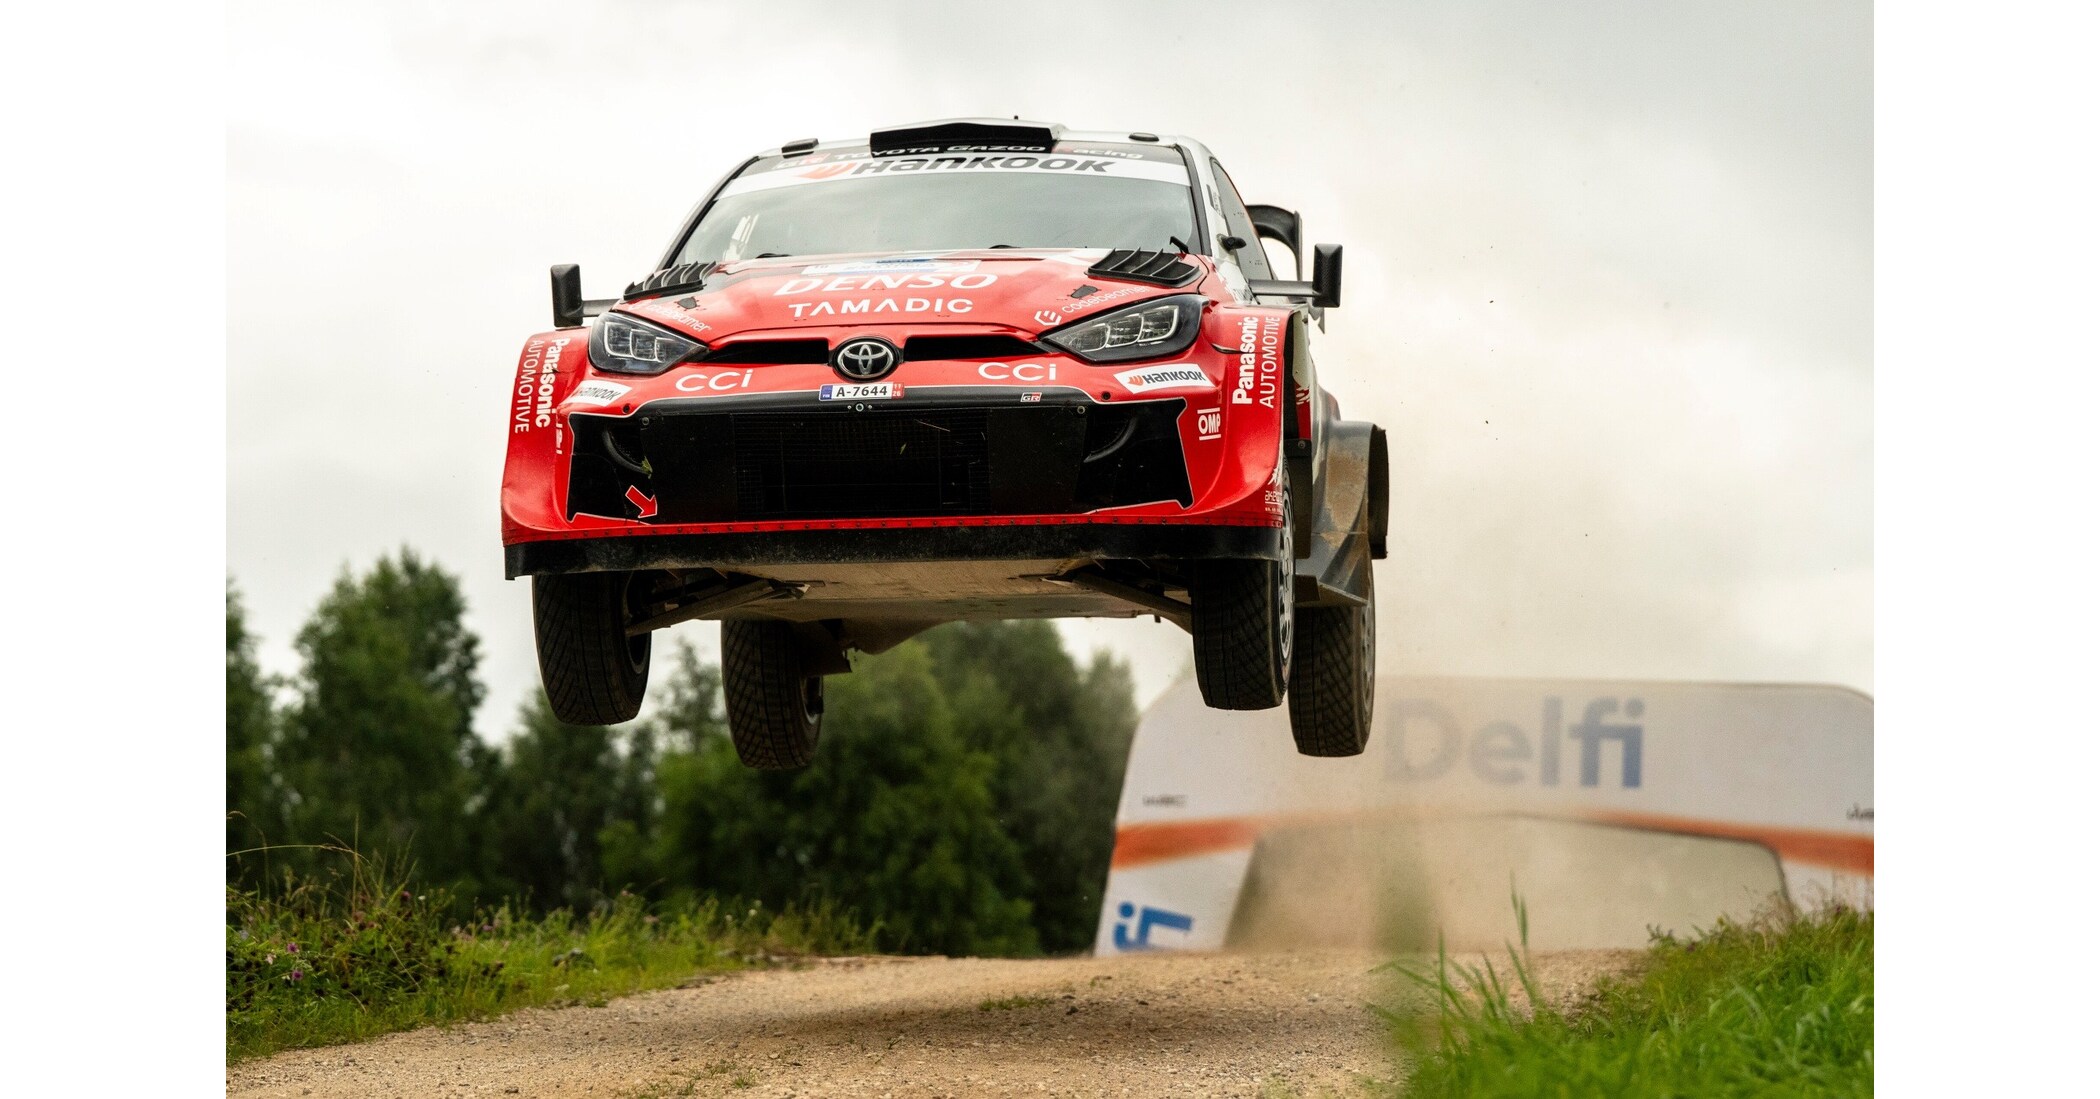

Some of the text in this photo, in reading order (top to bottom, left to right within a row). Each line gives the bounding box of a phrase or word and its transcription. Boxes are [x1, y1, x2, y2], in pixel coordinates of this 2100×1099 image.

[834, 146, 940, 160] TOYOTA
[946, 145, 1046, 153] GAZOO
[773, 273, 998, 296] DENSO
[788, 298, 974, 318] TAMADIC
[1061, 285, 1150, 313] codebeamer
[1232, 317, 1259, 404] Panasonic
[1259, 317, 1281, 409] AUTOMOTIVE
[515, 340, 545, 434] AUTOMOTIVE
[535, 337, 571, 428] Panasonic
[836, 385, 888, 397] A-7644
[1198, 413, 1221, 434] OMP
[1384, 695, 1646, 788] Delfi
